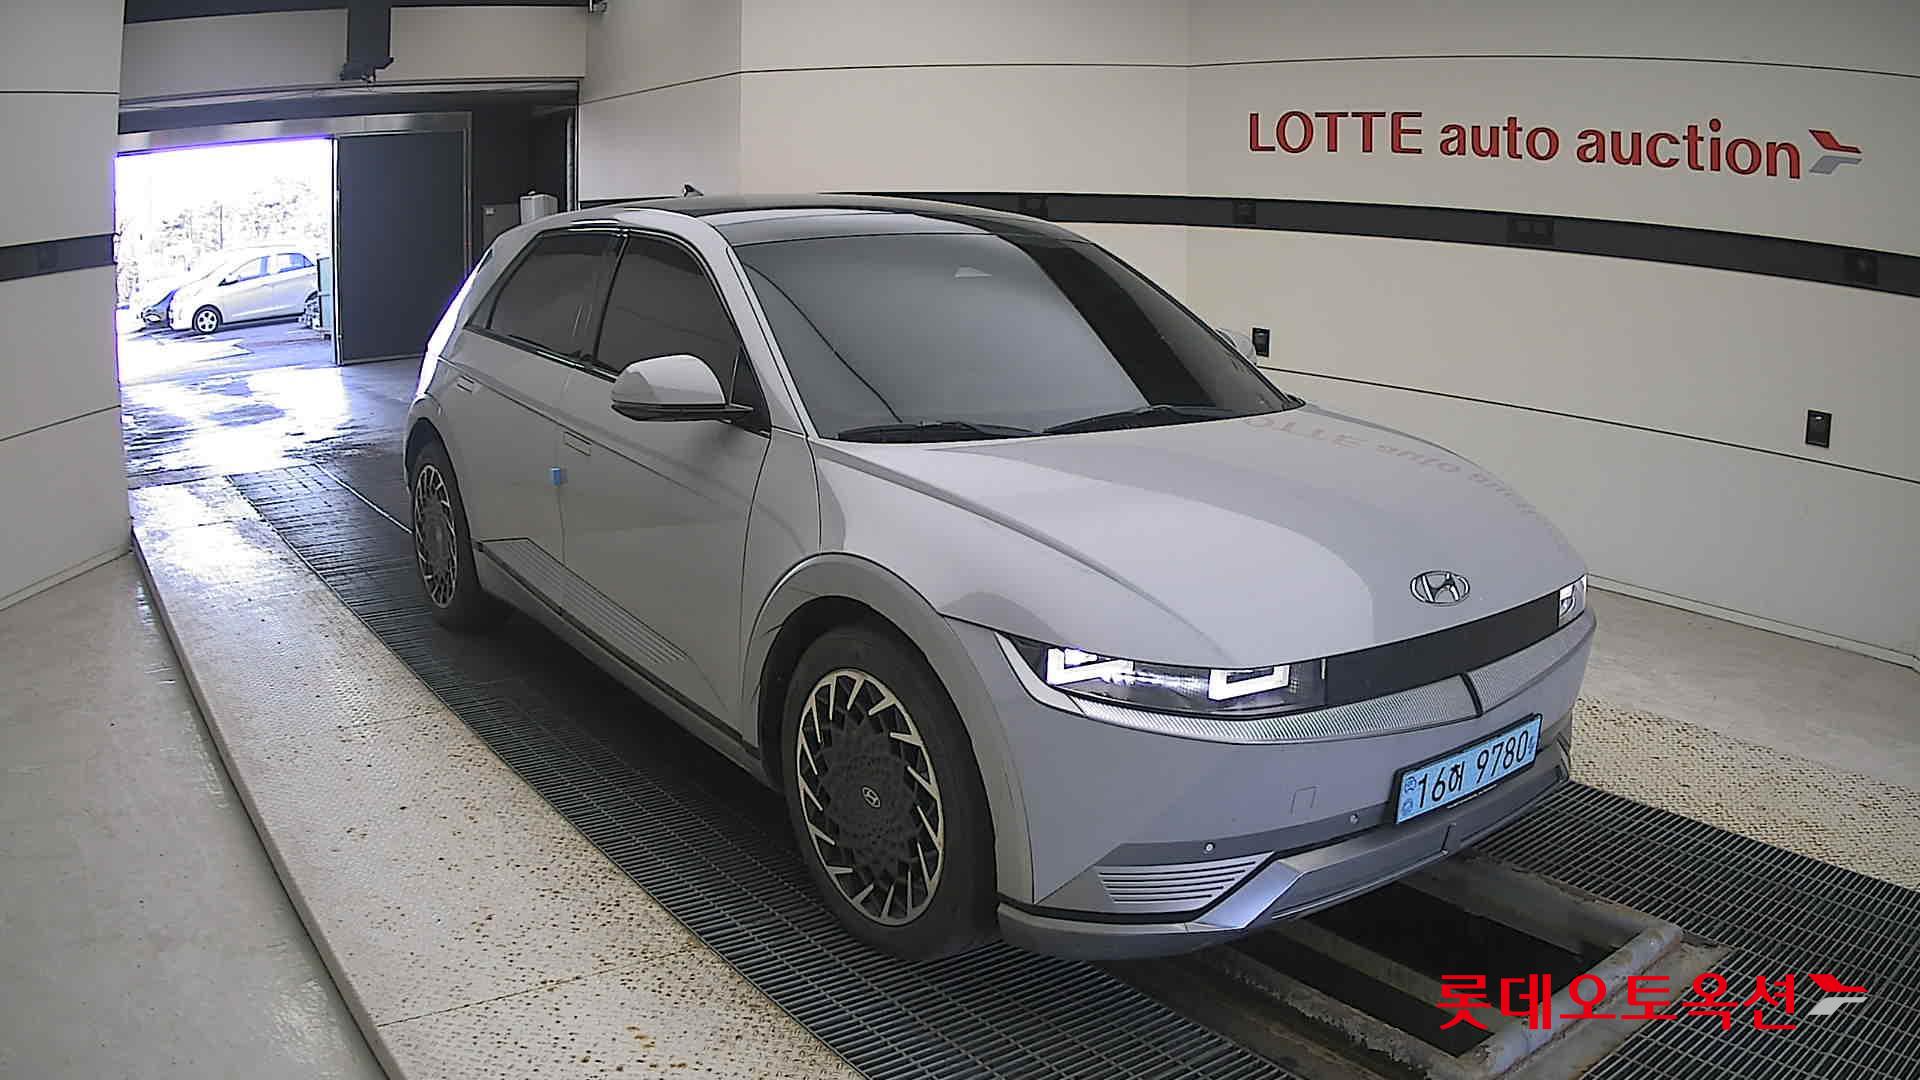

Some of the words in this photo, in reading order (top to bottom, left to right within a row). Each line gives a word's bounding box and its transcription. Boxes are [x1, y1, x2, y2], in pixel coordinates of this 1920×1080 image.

[1249, 111, 1424, 155] LOTTE
[1439, 116, 1560, 161] auto
[1576, 119, 1802, 178] auction
[1418, 761, 1465, 808] 16허
[1476, 730, 1528, 784] 9780
